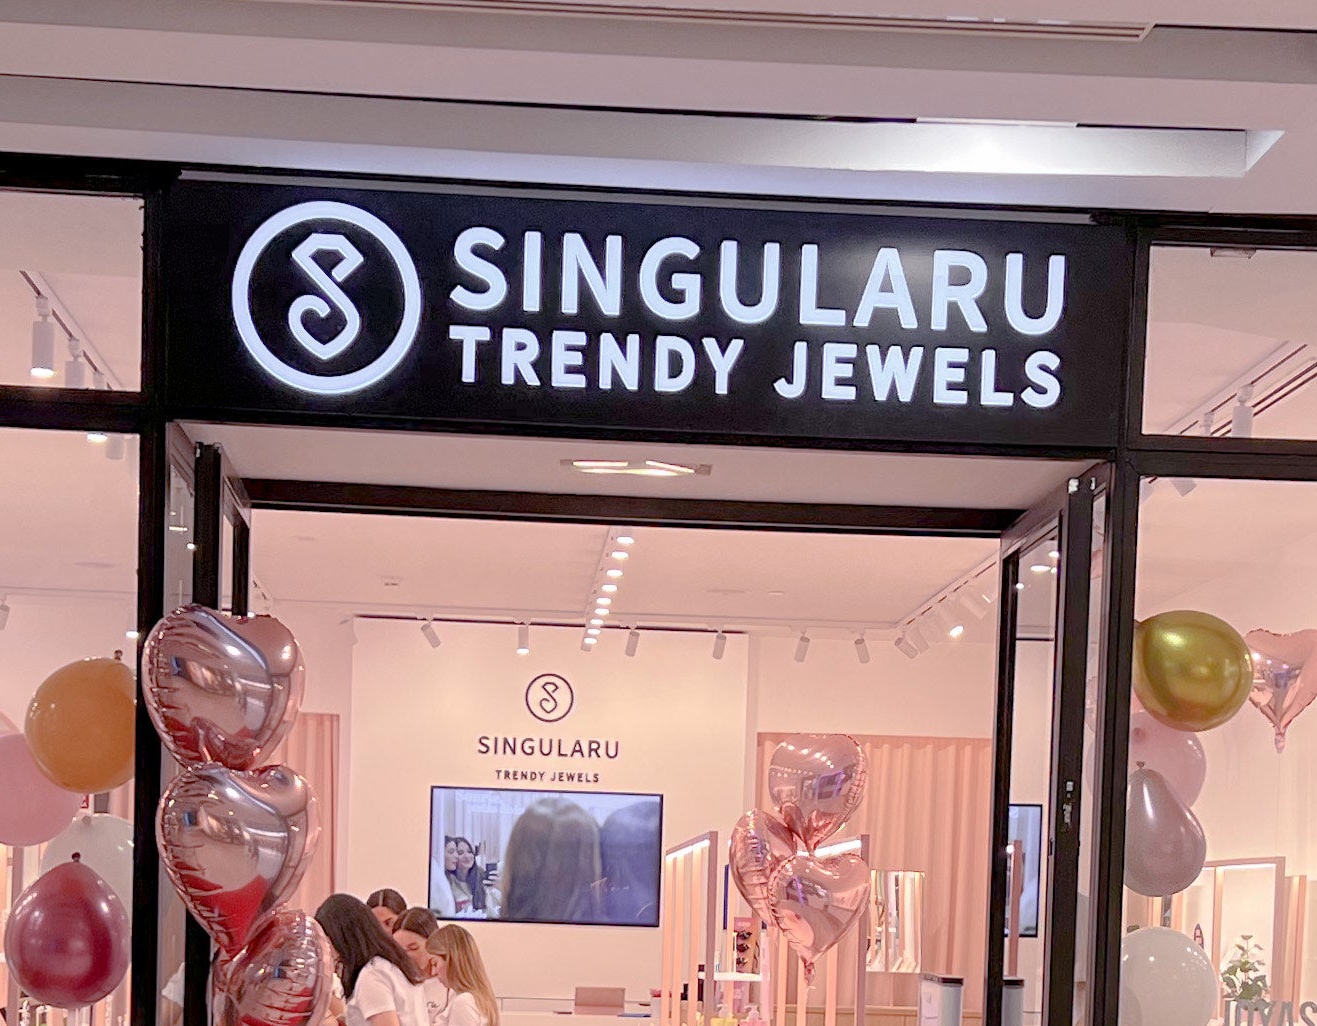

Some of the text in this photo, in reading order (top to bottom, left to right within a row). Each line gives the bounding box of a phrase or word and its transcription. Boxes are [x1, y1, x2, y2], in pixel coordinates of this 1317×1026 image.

[449, 225, 1067, 336] SINGULARU
[449, 324, 1063, 410] TRENDY JEWELS
[477, 735, 620, 760] SINGULARU
[495, 769, 600, 784] TRENDY JEWELS
